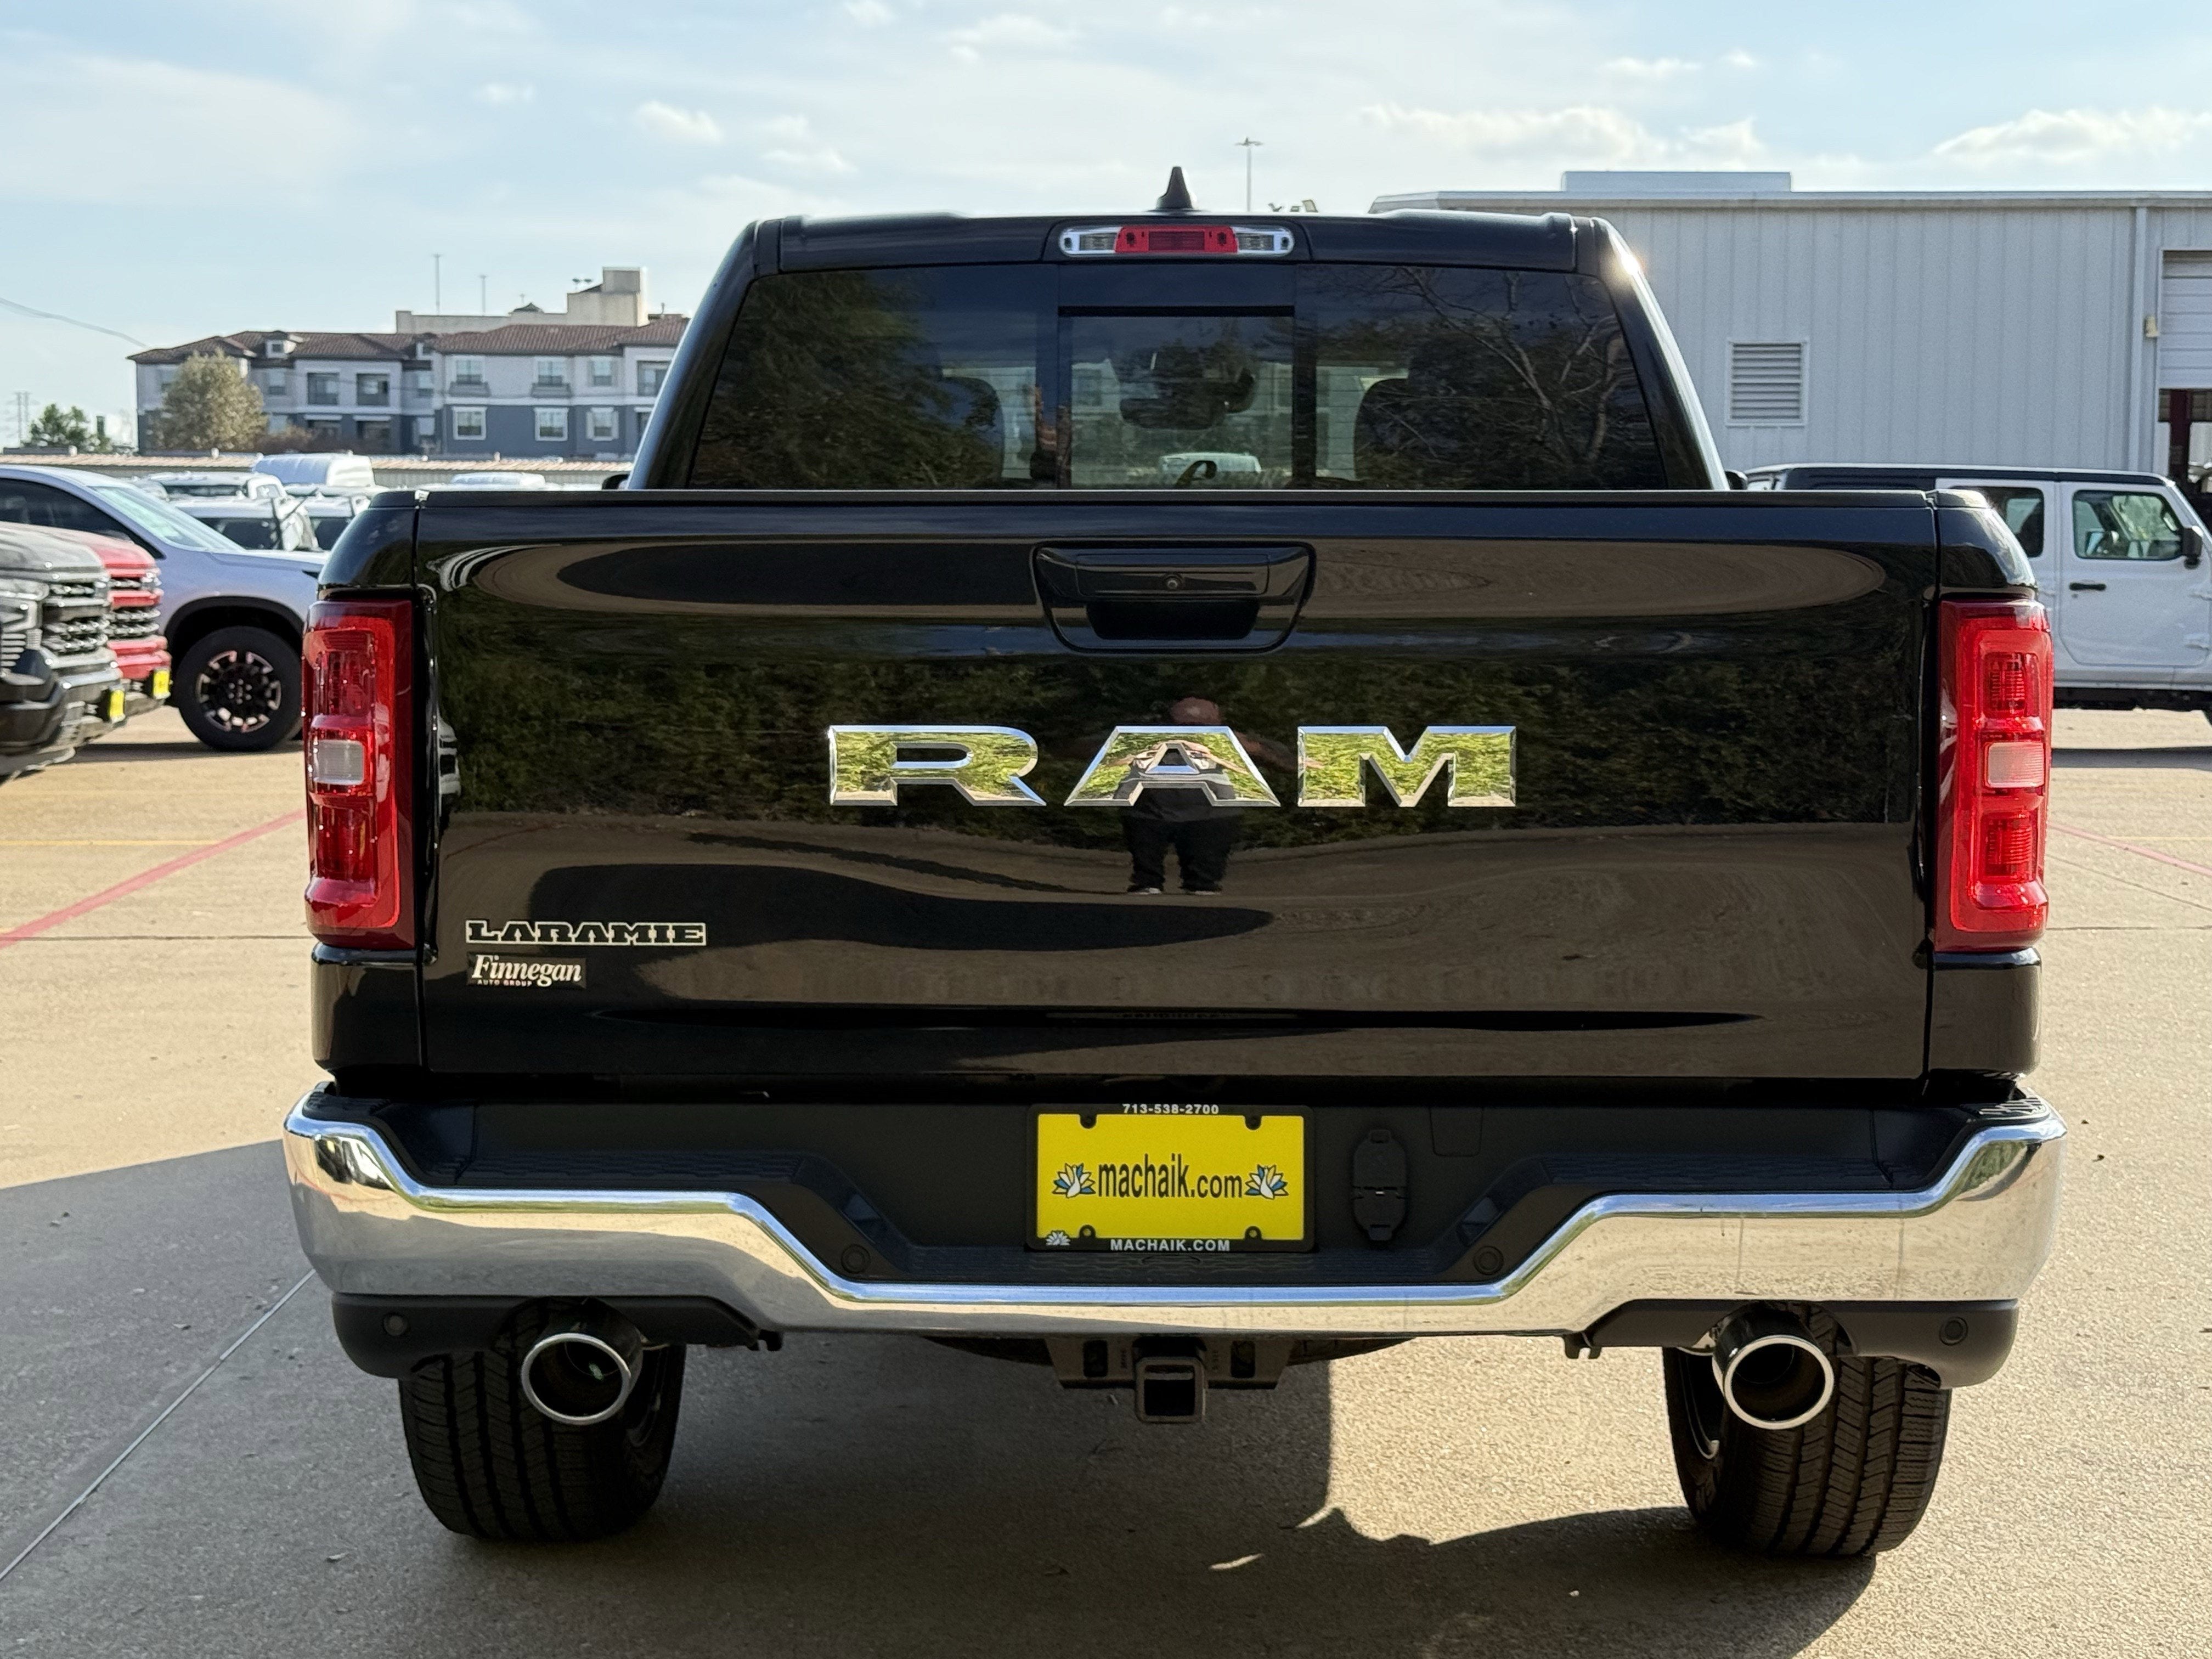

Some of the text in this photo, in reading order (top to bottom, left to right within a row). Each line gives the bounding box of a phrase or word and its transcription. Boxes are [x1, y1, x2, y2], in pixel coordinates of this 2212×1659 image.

[828, 724, 1517, 808] RAM
[465, 919, 707, 946] LARAMIE
[471, 955, 582, 987] Finnegan
[503, 979, 533, 987] GROUP
[1122, 1104, 1219, 1114] 713-538-2700
[1098, 1153, 1243, 1198] machaik.com
[1110, 1239, 1230, 1251] MACHAIK.COM
